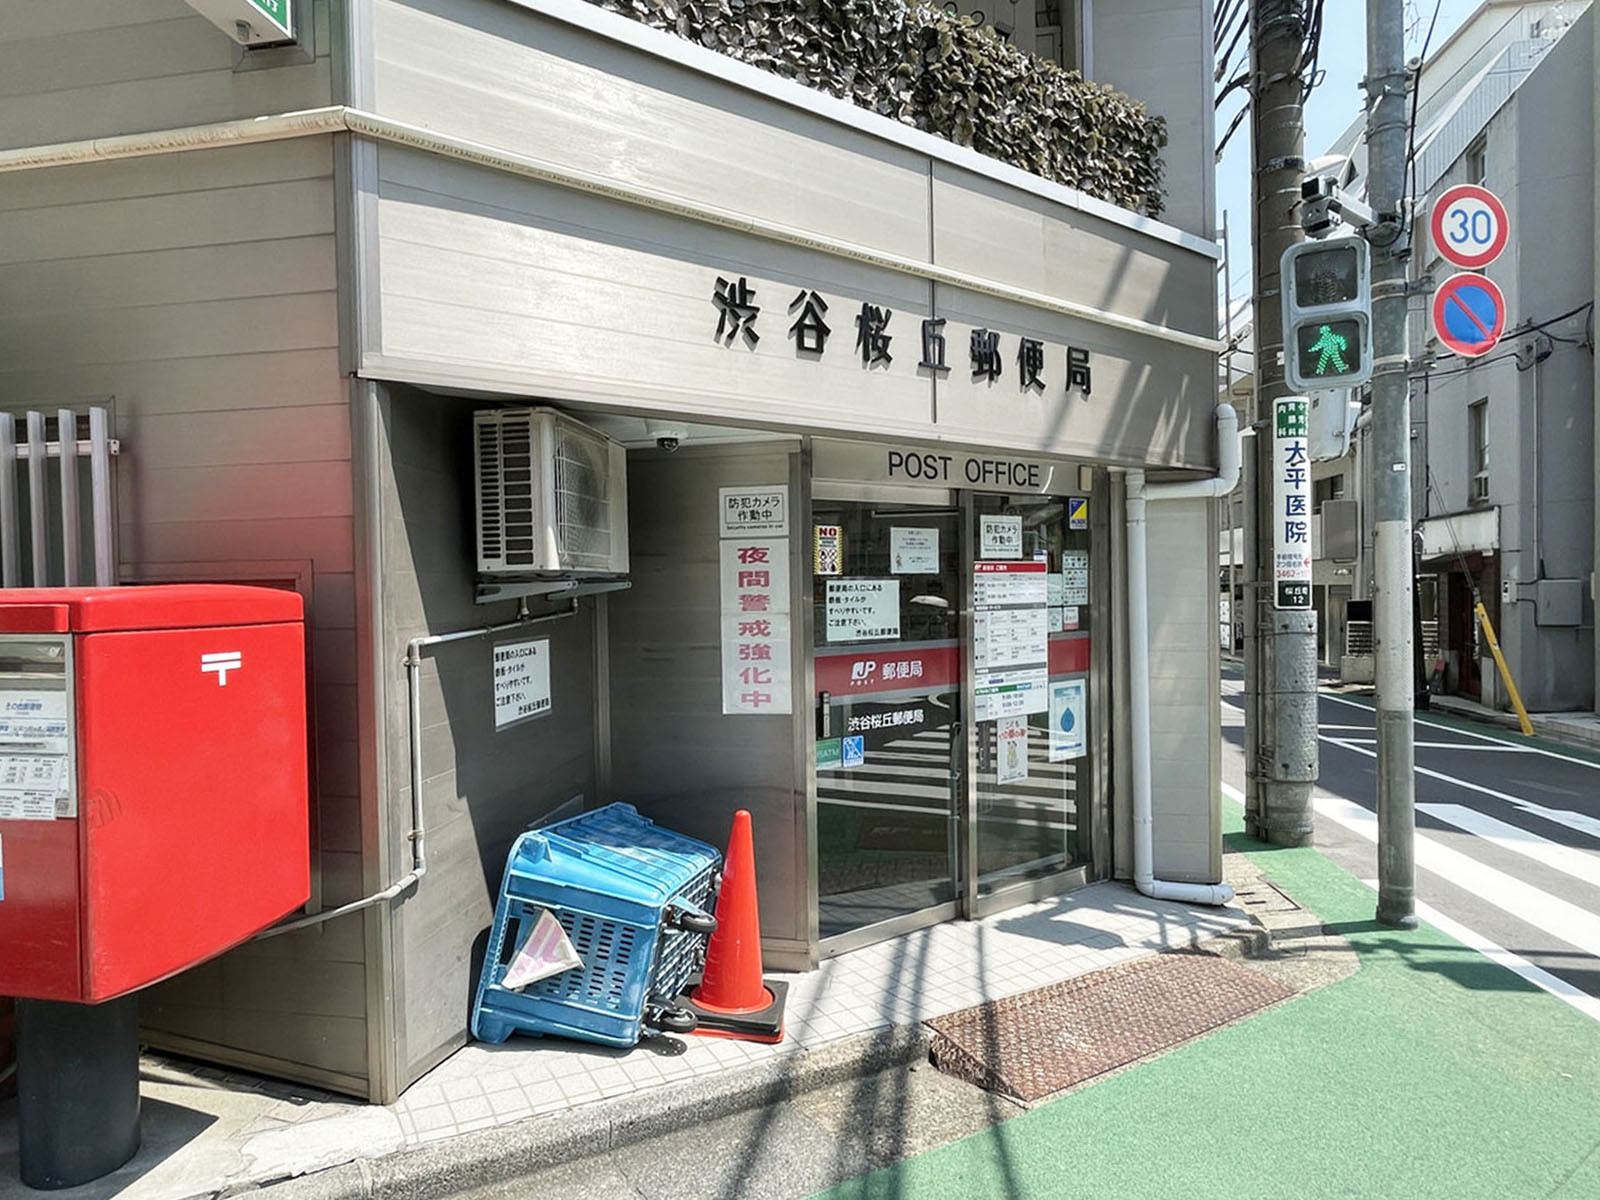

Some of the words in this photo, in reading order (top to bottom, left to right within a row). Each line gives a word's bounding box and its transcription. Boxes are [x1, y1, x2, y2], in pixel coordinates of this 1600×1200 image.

[1449, 208, 1491, 245] 30
[712, 276, 1092, 395] 渋谷桜丘郵便局
[888, 451, 952, 480] POST
[965, 458, 1040, 487] OFFICE
[728, 496, 780, 509] 防犯カメラ
[738, 509, 772, 520] 作動中
[819, 527, 837, 537] NO
[1293, 595, 1304, 604] 12
[737, 546, 772, 708] 夜間警戒強化中
[882, 660, 923, 680] 郵便局
[848, 709, 924, 732] 渋谷桜丘郵便局
